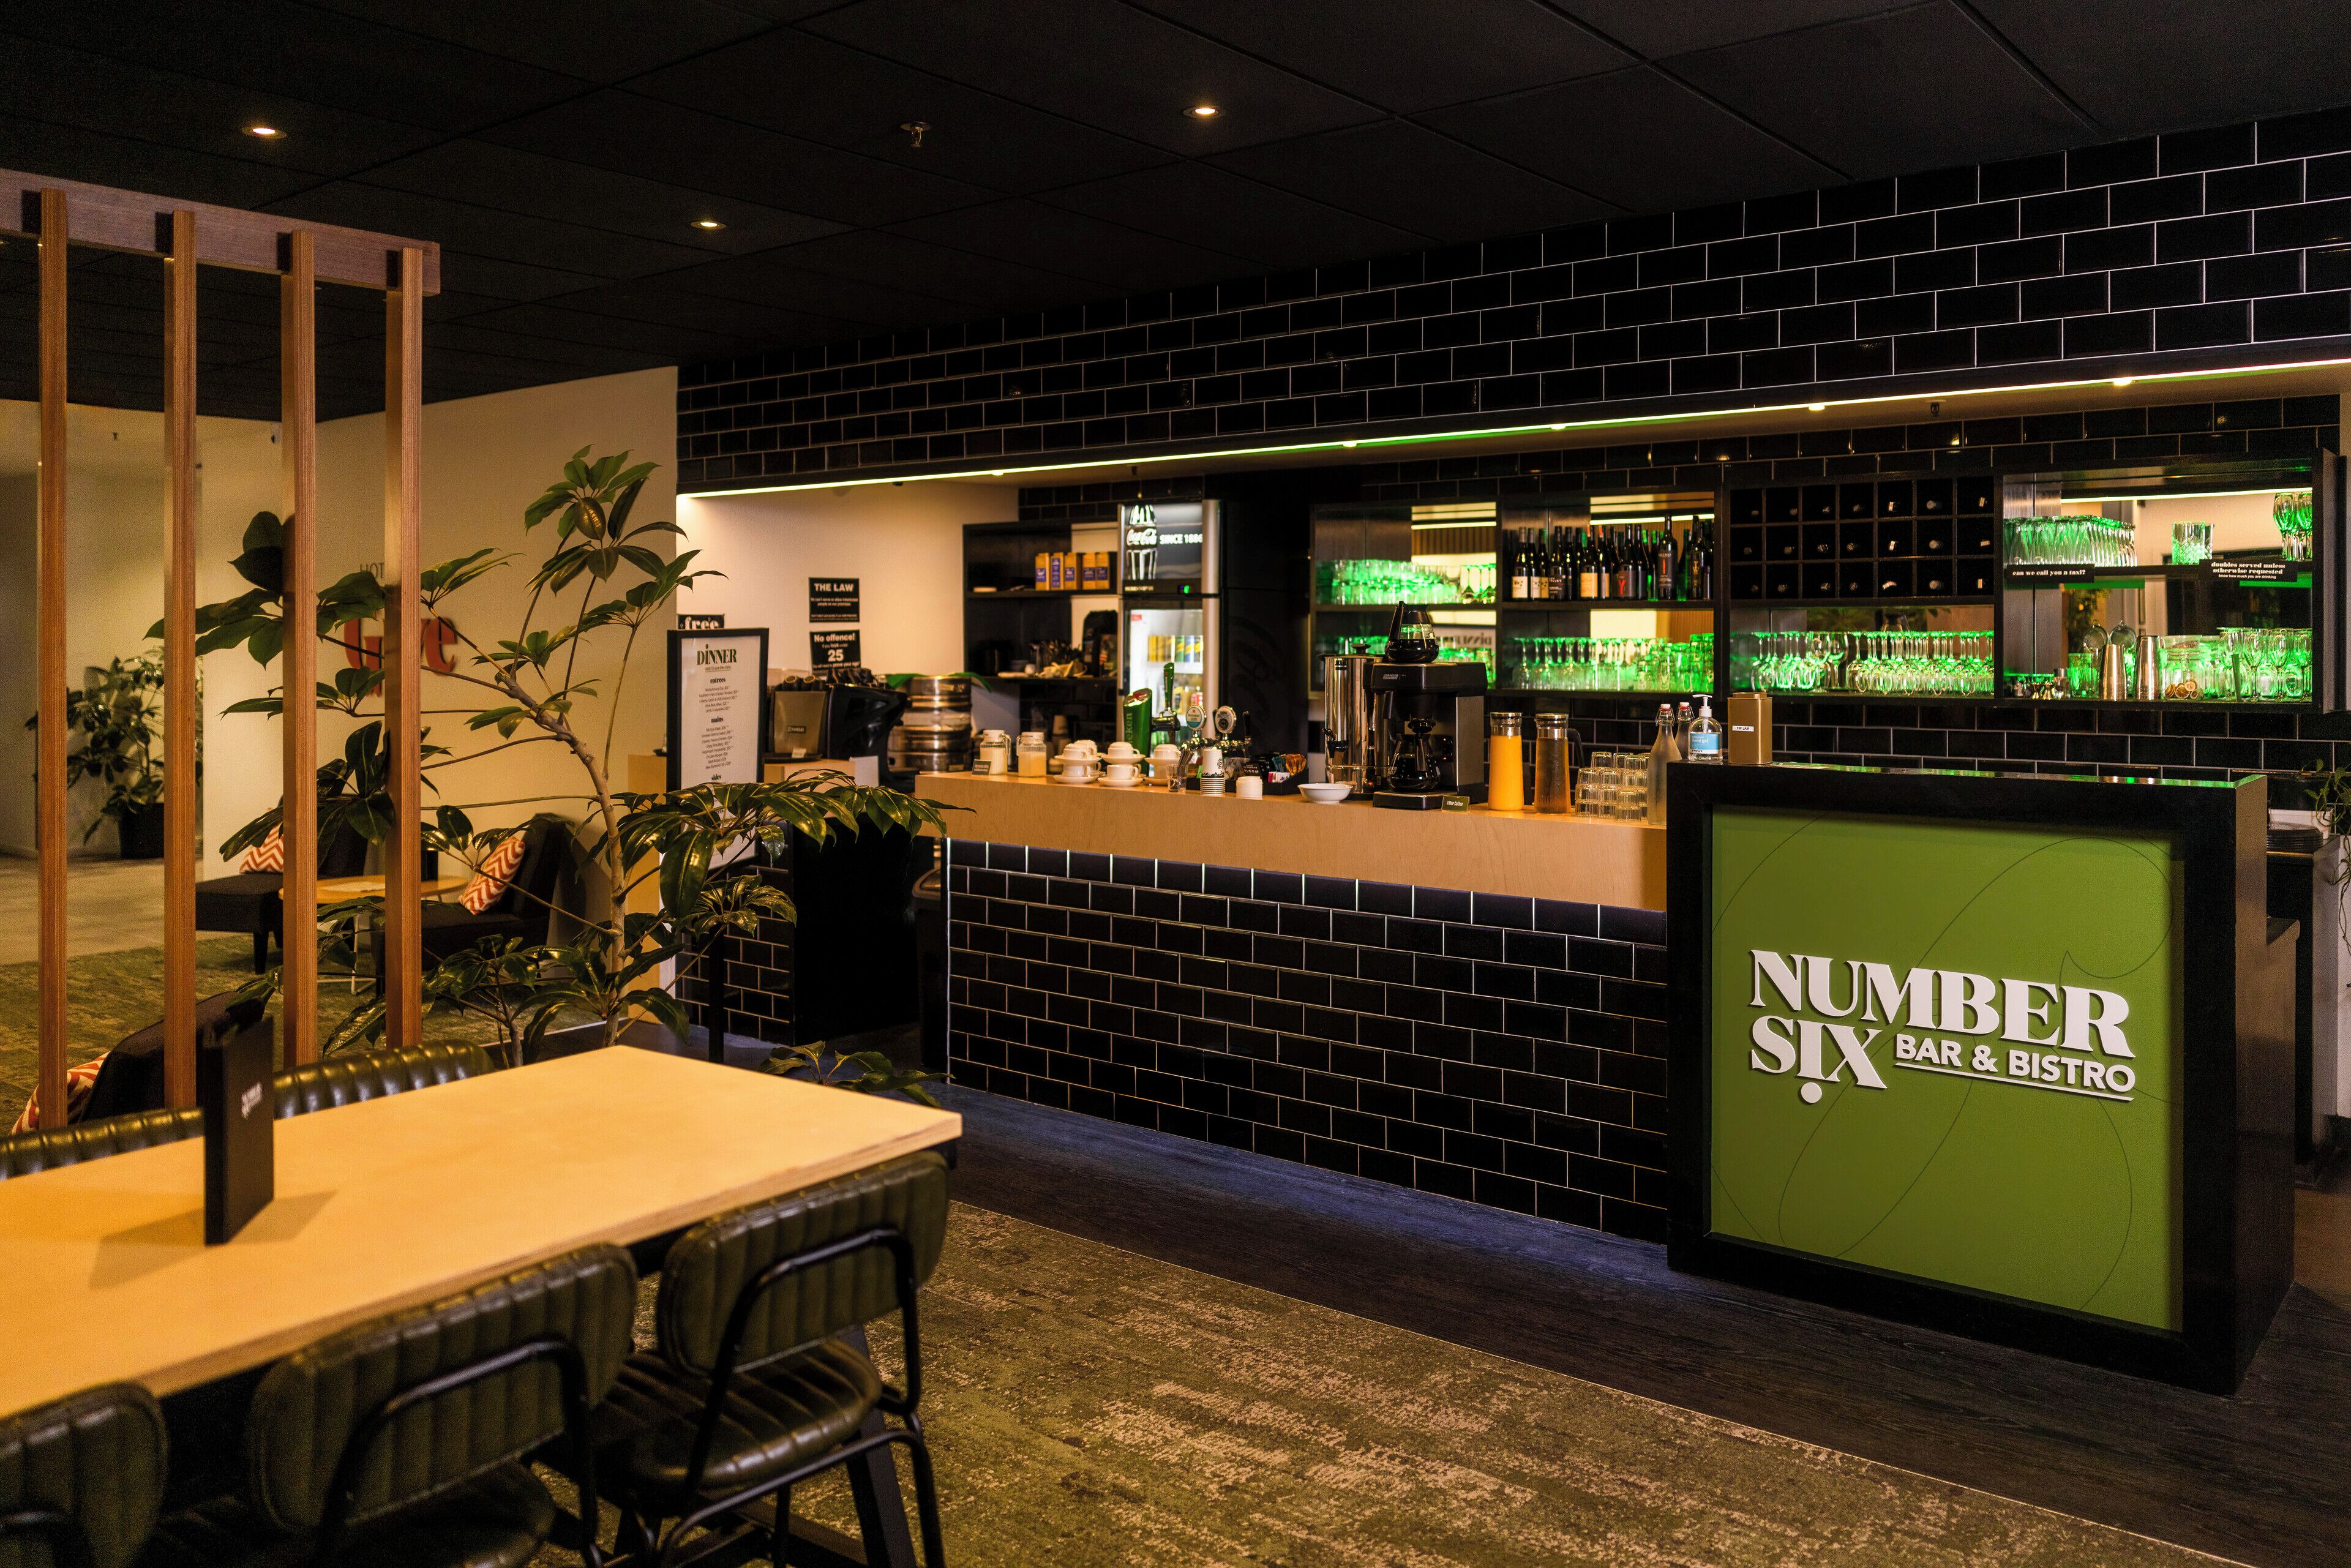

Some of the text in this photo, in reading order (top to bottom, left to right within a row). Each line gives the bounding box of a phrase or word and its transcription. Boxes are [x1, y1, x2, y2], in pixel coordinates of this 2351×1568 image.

[1160, 534, 1183, 544] SINCE
[814, 583, 854, 592] THE LAW
[684, 616, 719, 630] free
[814, 632, 855, 642] No offence!
[827, 649, 844, 662] 25
[1749, 950, 2135, 1058] NUMBER
[1751, 1015, 1888, 1103] SIX
[1895, 1033, 2136, 1093] BAR & BISTRO
